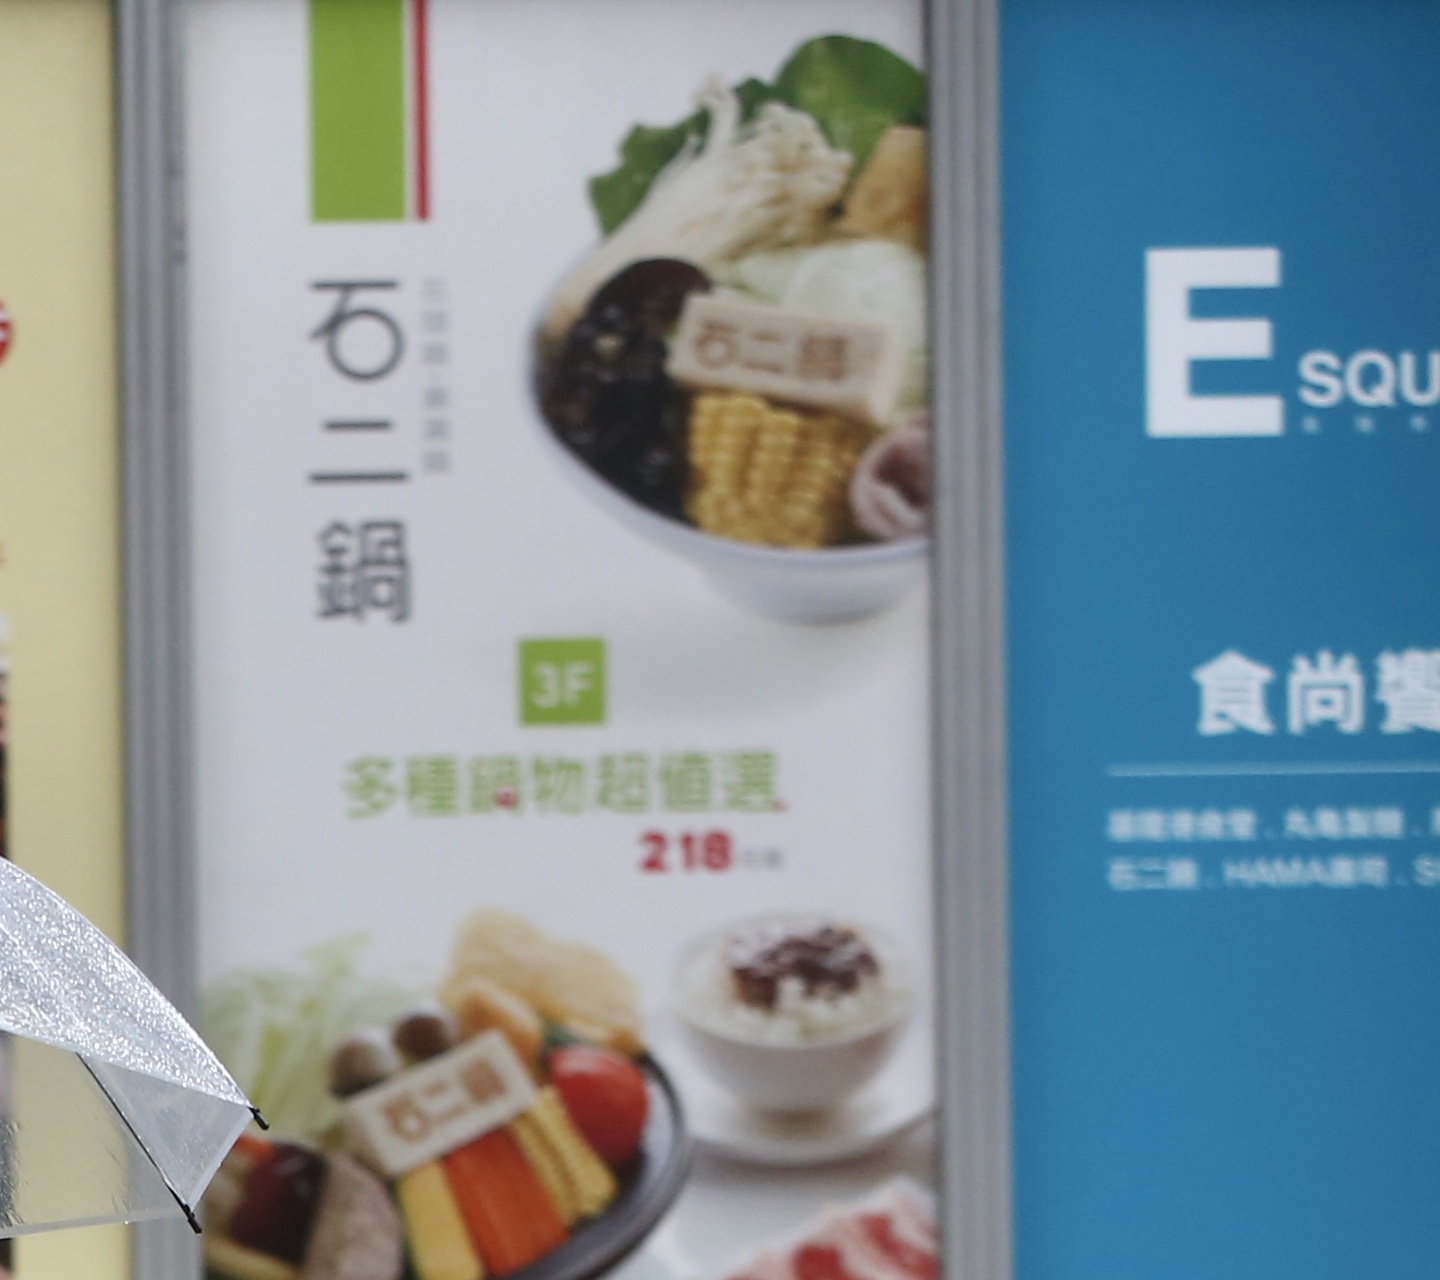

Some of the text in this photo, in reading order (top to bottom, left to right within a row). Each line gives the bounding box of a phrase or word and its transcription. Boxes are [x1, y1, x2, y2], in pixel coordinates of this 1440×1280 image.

[1144, 246, 1440, 438] E SQU
[309, 278, 413, 623] 石二鍋
[533, 660, 594, 708] 3F
[640, 829, 733, 873] 218
